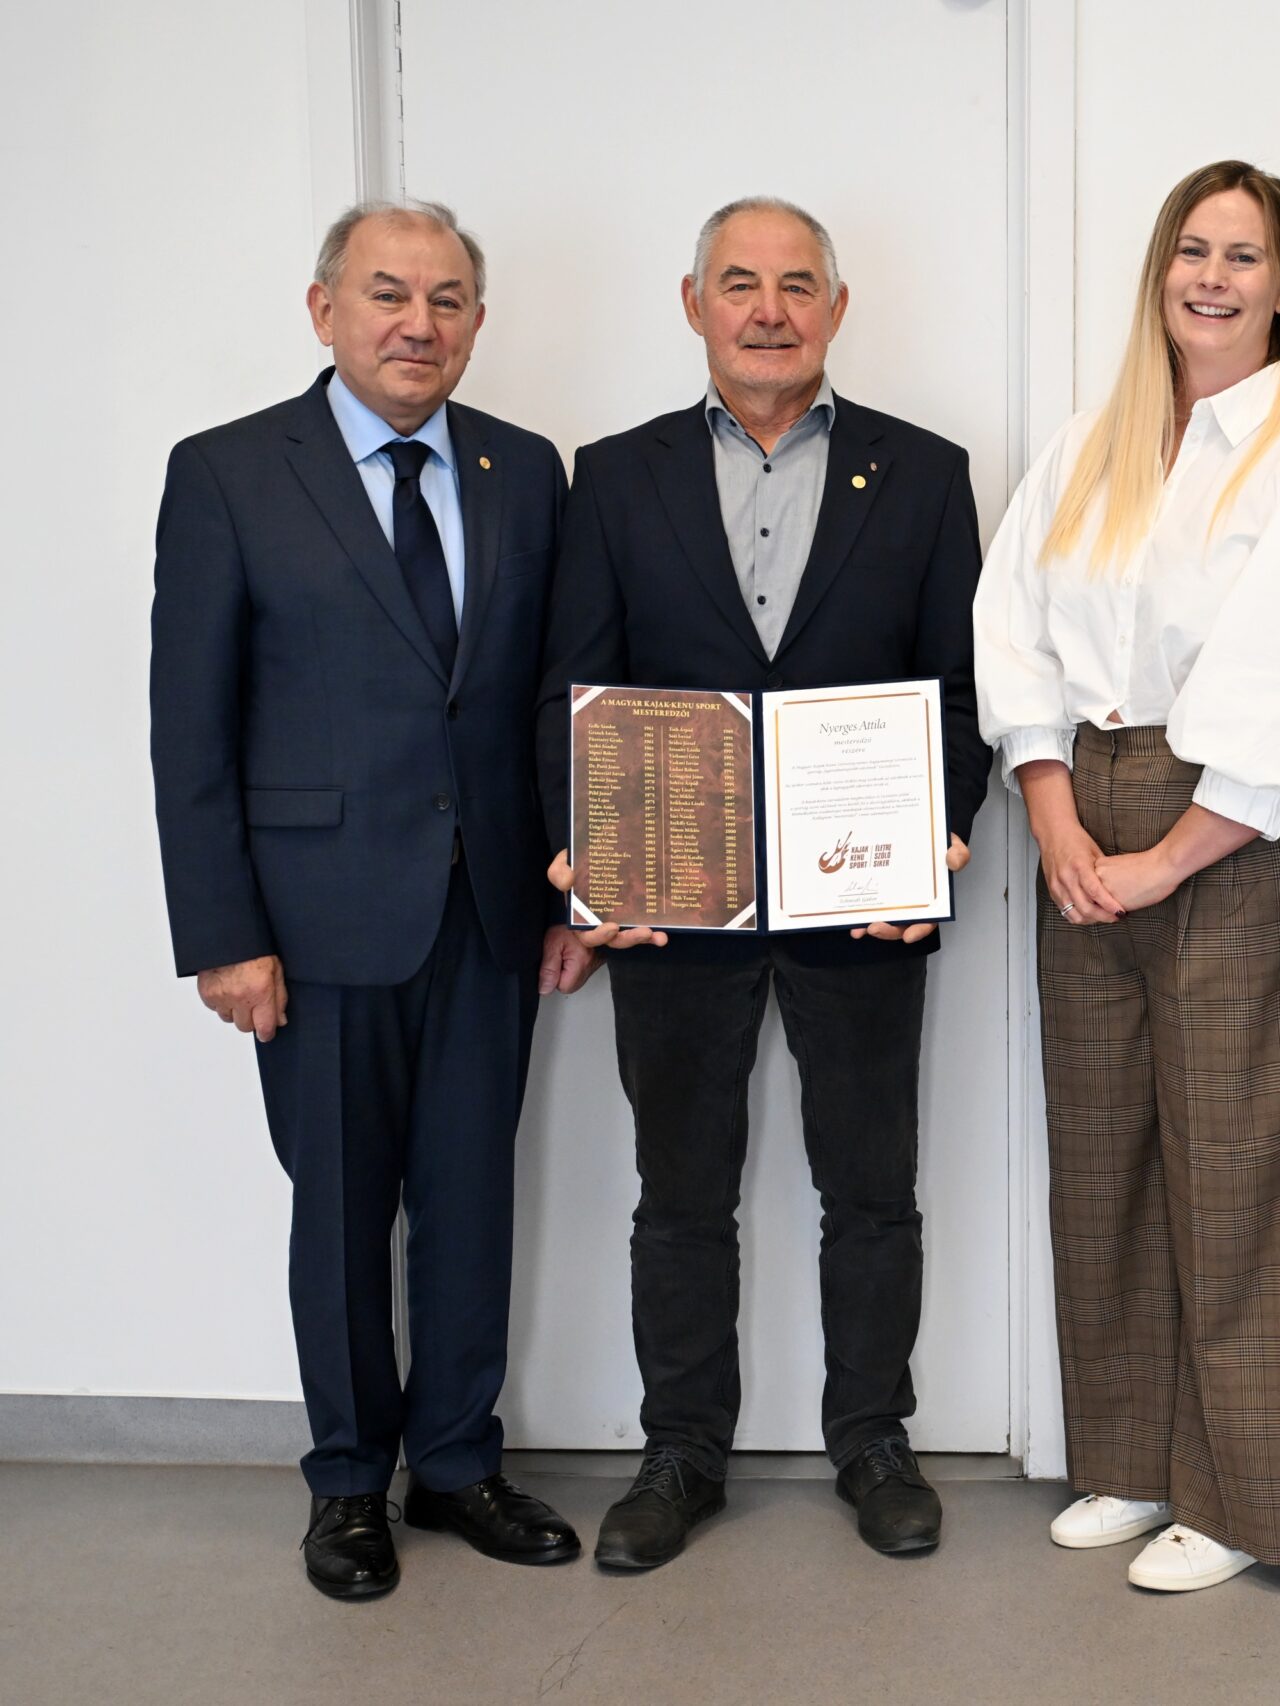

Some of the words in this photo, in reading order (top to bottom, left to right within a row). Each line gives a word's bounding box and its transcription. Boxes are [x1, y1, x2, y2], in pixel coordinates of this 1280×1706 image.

[608, 699, 642, 707] MAGYAR
[644, 700, 694, 709] KAJAK-KENU
[632, 708, 690, 718] MESTEREDZŐI
[819, 722, 857, 736] Nyerges
[858, 718, 886, 731] Attila
[849, 861, 868, 870] SPORT
